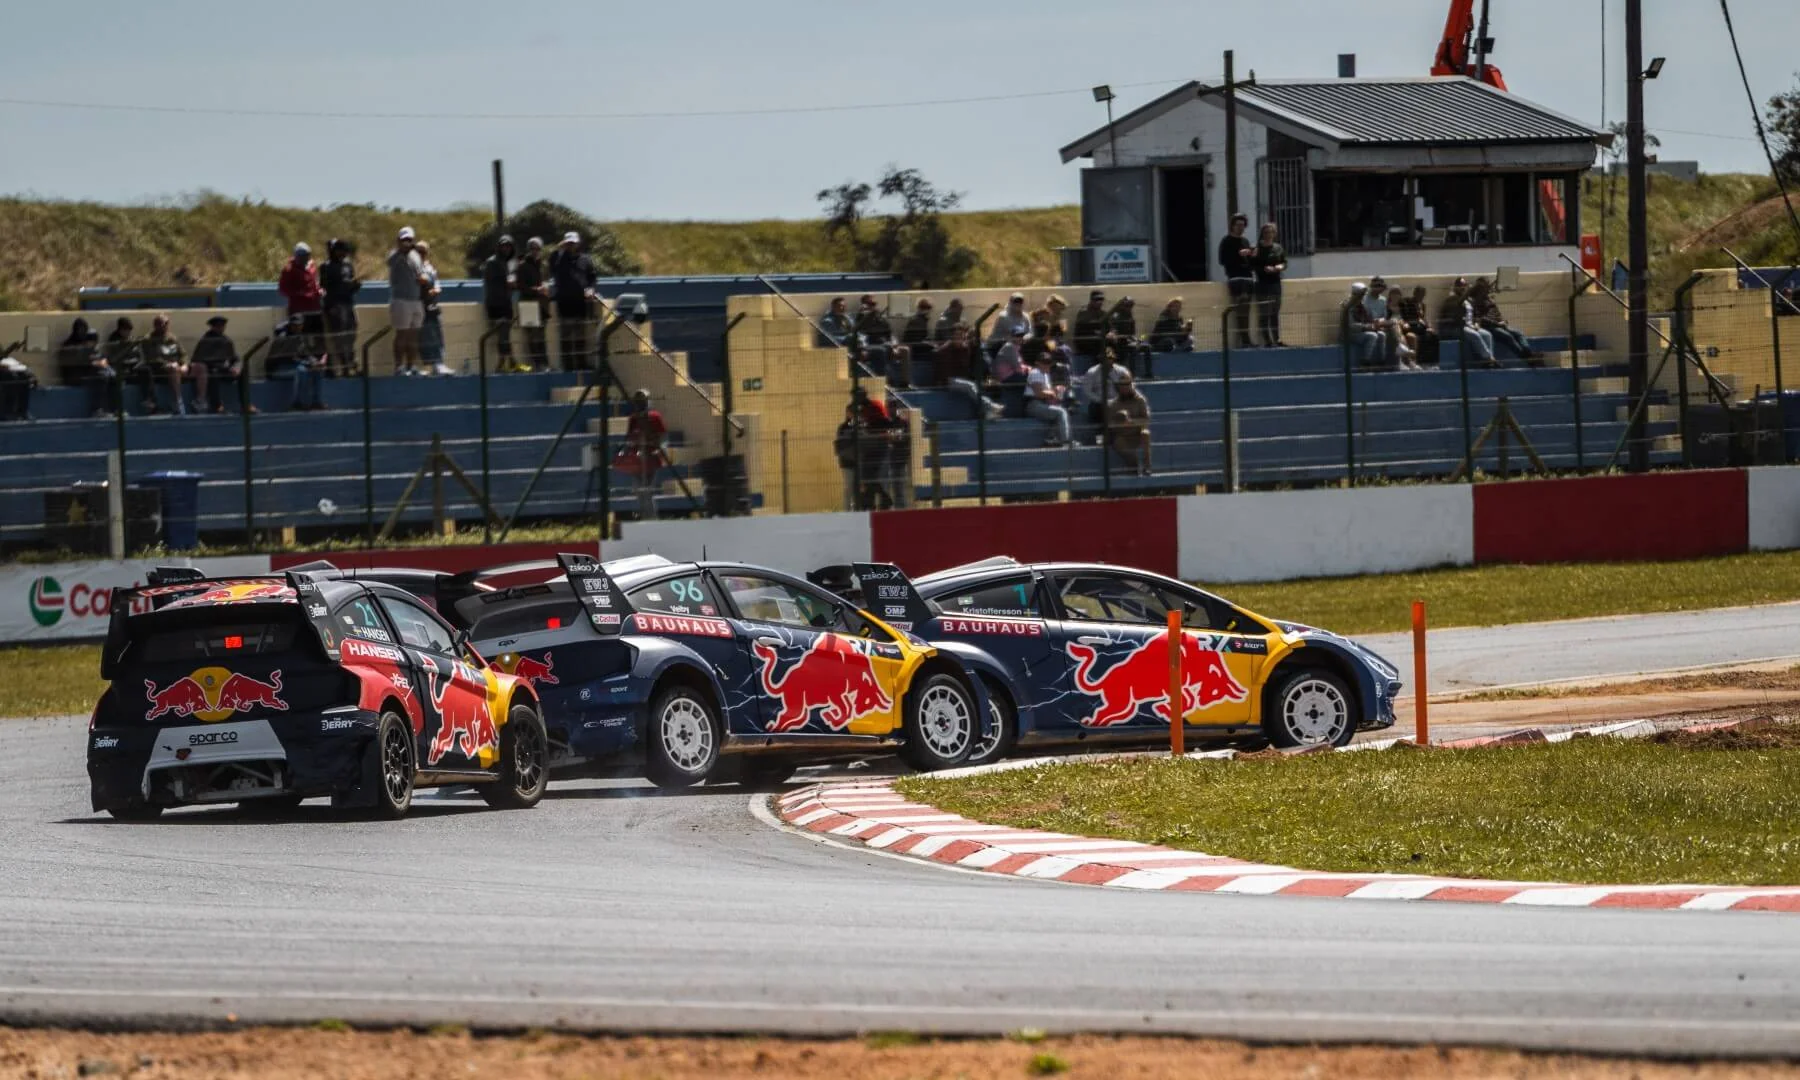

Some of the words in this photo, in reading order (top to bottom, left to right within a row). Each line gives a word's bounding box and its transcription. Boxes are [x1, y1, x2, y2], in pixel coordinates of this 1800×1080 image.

[669, 580, 704, 602] 96
[879, 586, 908, 597] EWJ
[1012, 583, 1028, 606] 1
[355, 601, 380, 627] 21
[884, 606, 906, 616] OMP
[962, 607, 1022, 616] Kristoffersson
[600, 615, 619, 623] Castrol
[637, 616, 730, 636] BAUHAUS
[360, 626, 391, 642] HANSEN
[943, 621, 1041, 635] BAUHAUS
[346, 642, 405, 662] HANSEN
[189, 730, 238, 745] sparco
